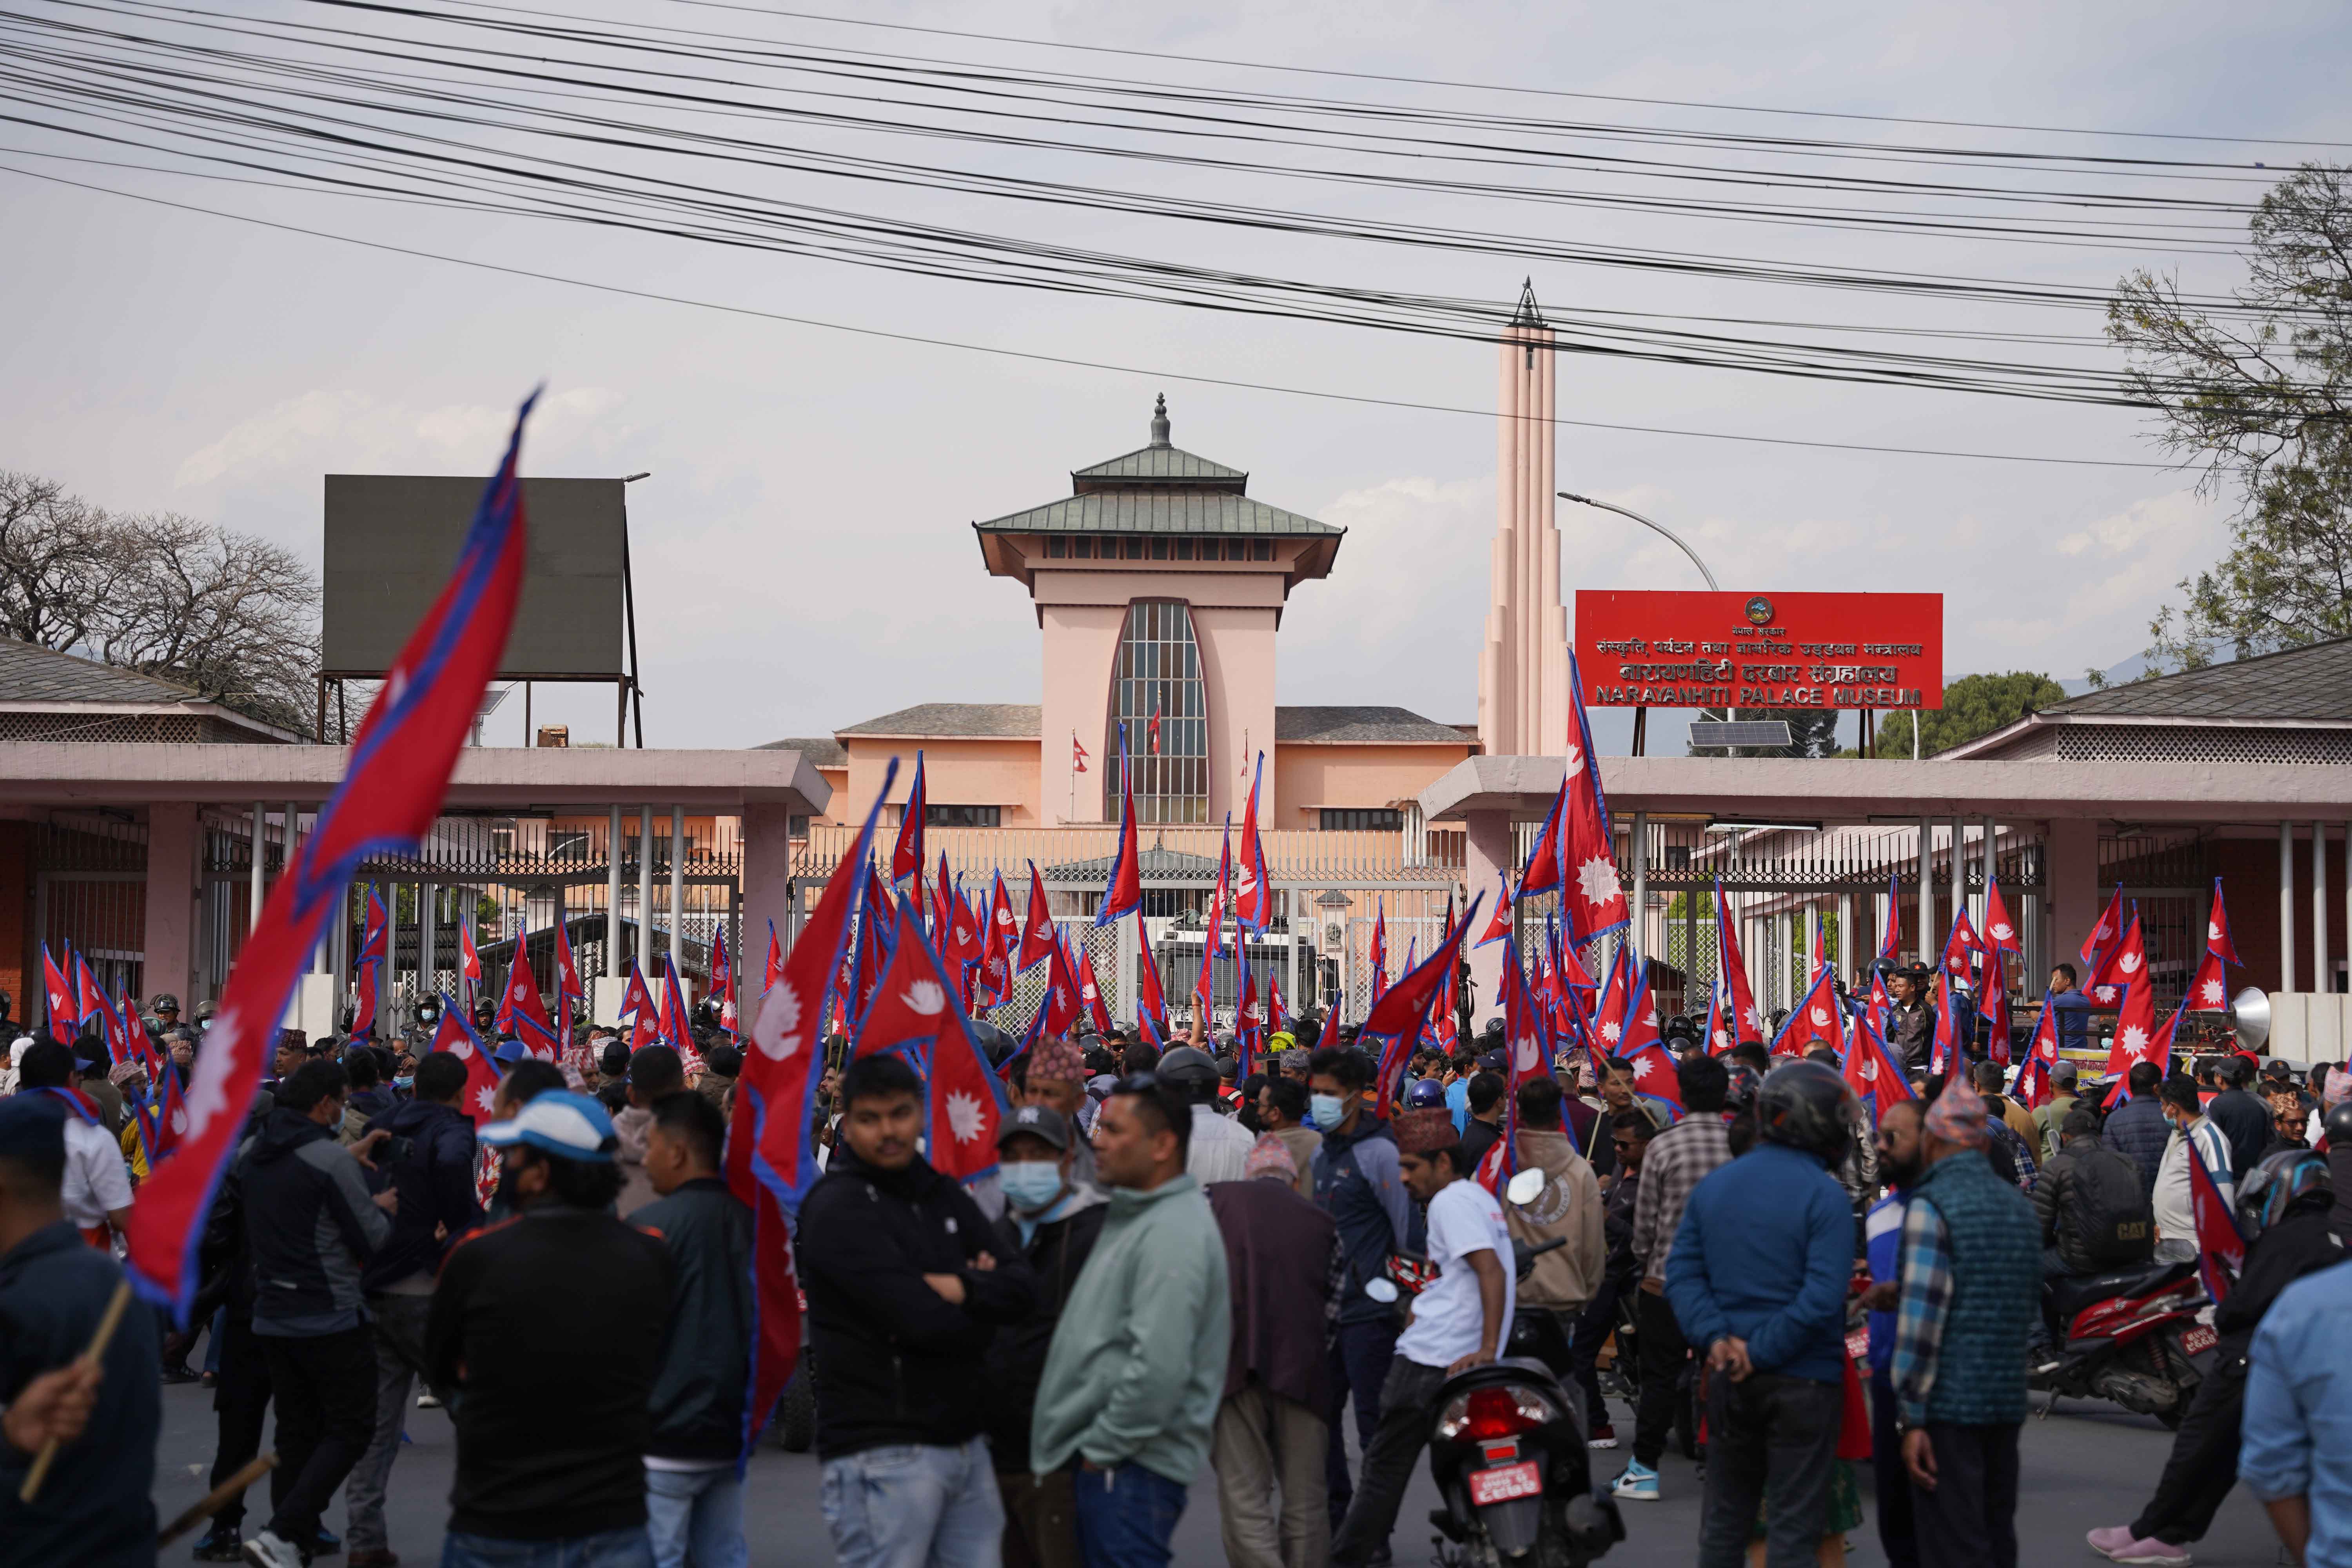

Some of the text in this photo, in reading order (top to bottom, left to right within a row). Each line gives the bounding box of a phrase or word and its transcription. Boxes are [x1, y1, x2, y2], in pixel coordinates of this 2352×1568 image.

[1732, 624, 1786, 636] नेपाल सरकार
[1596, 637, 1649, 657] संस्कृति,
[1653, 638, 1694, 653] पर्यटन
[1701, 642, 1729, 653] तथा
[1736, 639, 1793, 656] नागरिक
[1863, 643, 1922, 657] मन्त्रालय
[1619, 658, 1897, 684] नारायणहिटी दरबार संग्रहालय
[1596, 686, 1920, 705] NARAYANHITI PALACE MUSEUM
[2117, 1222, 2146, 1240] CAT
